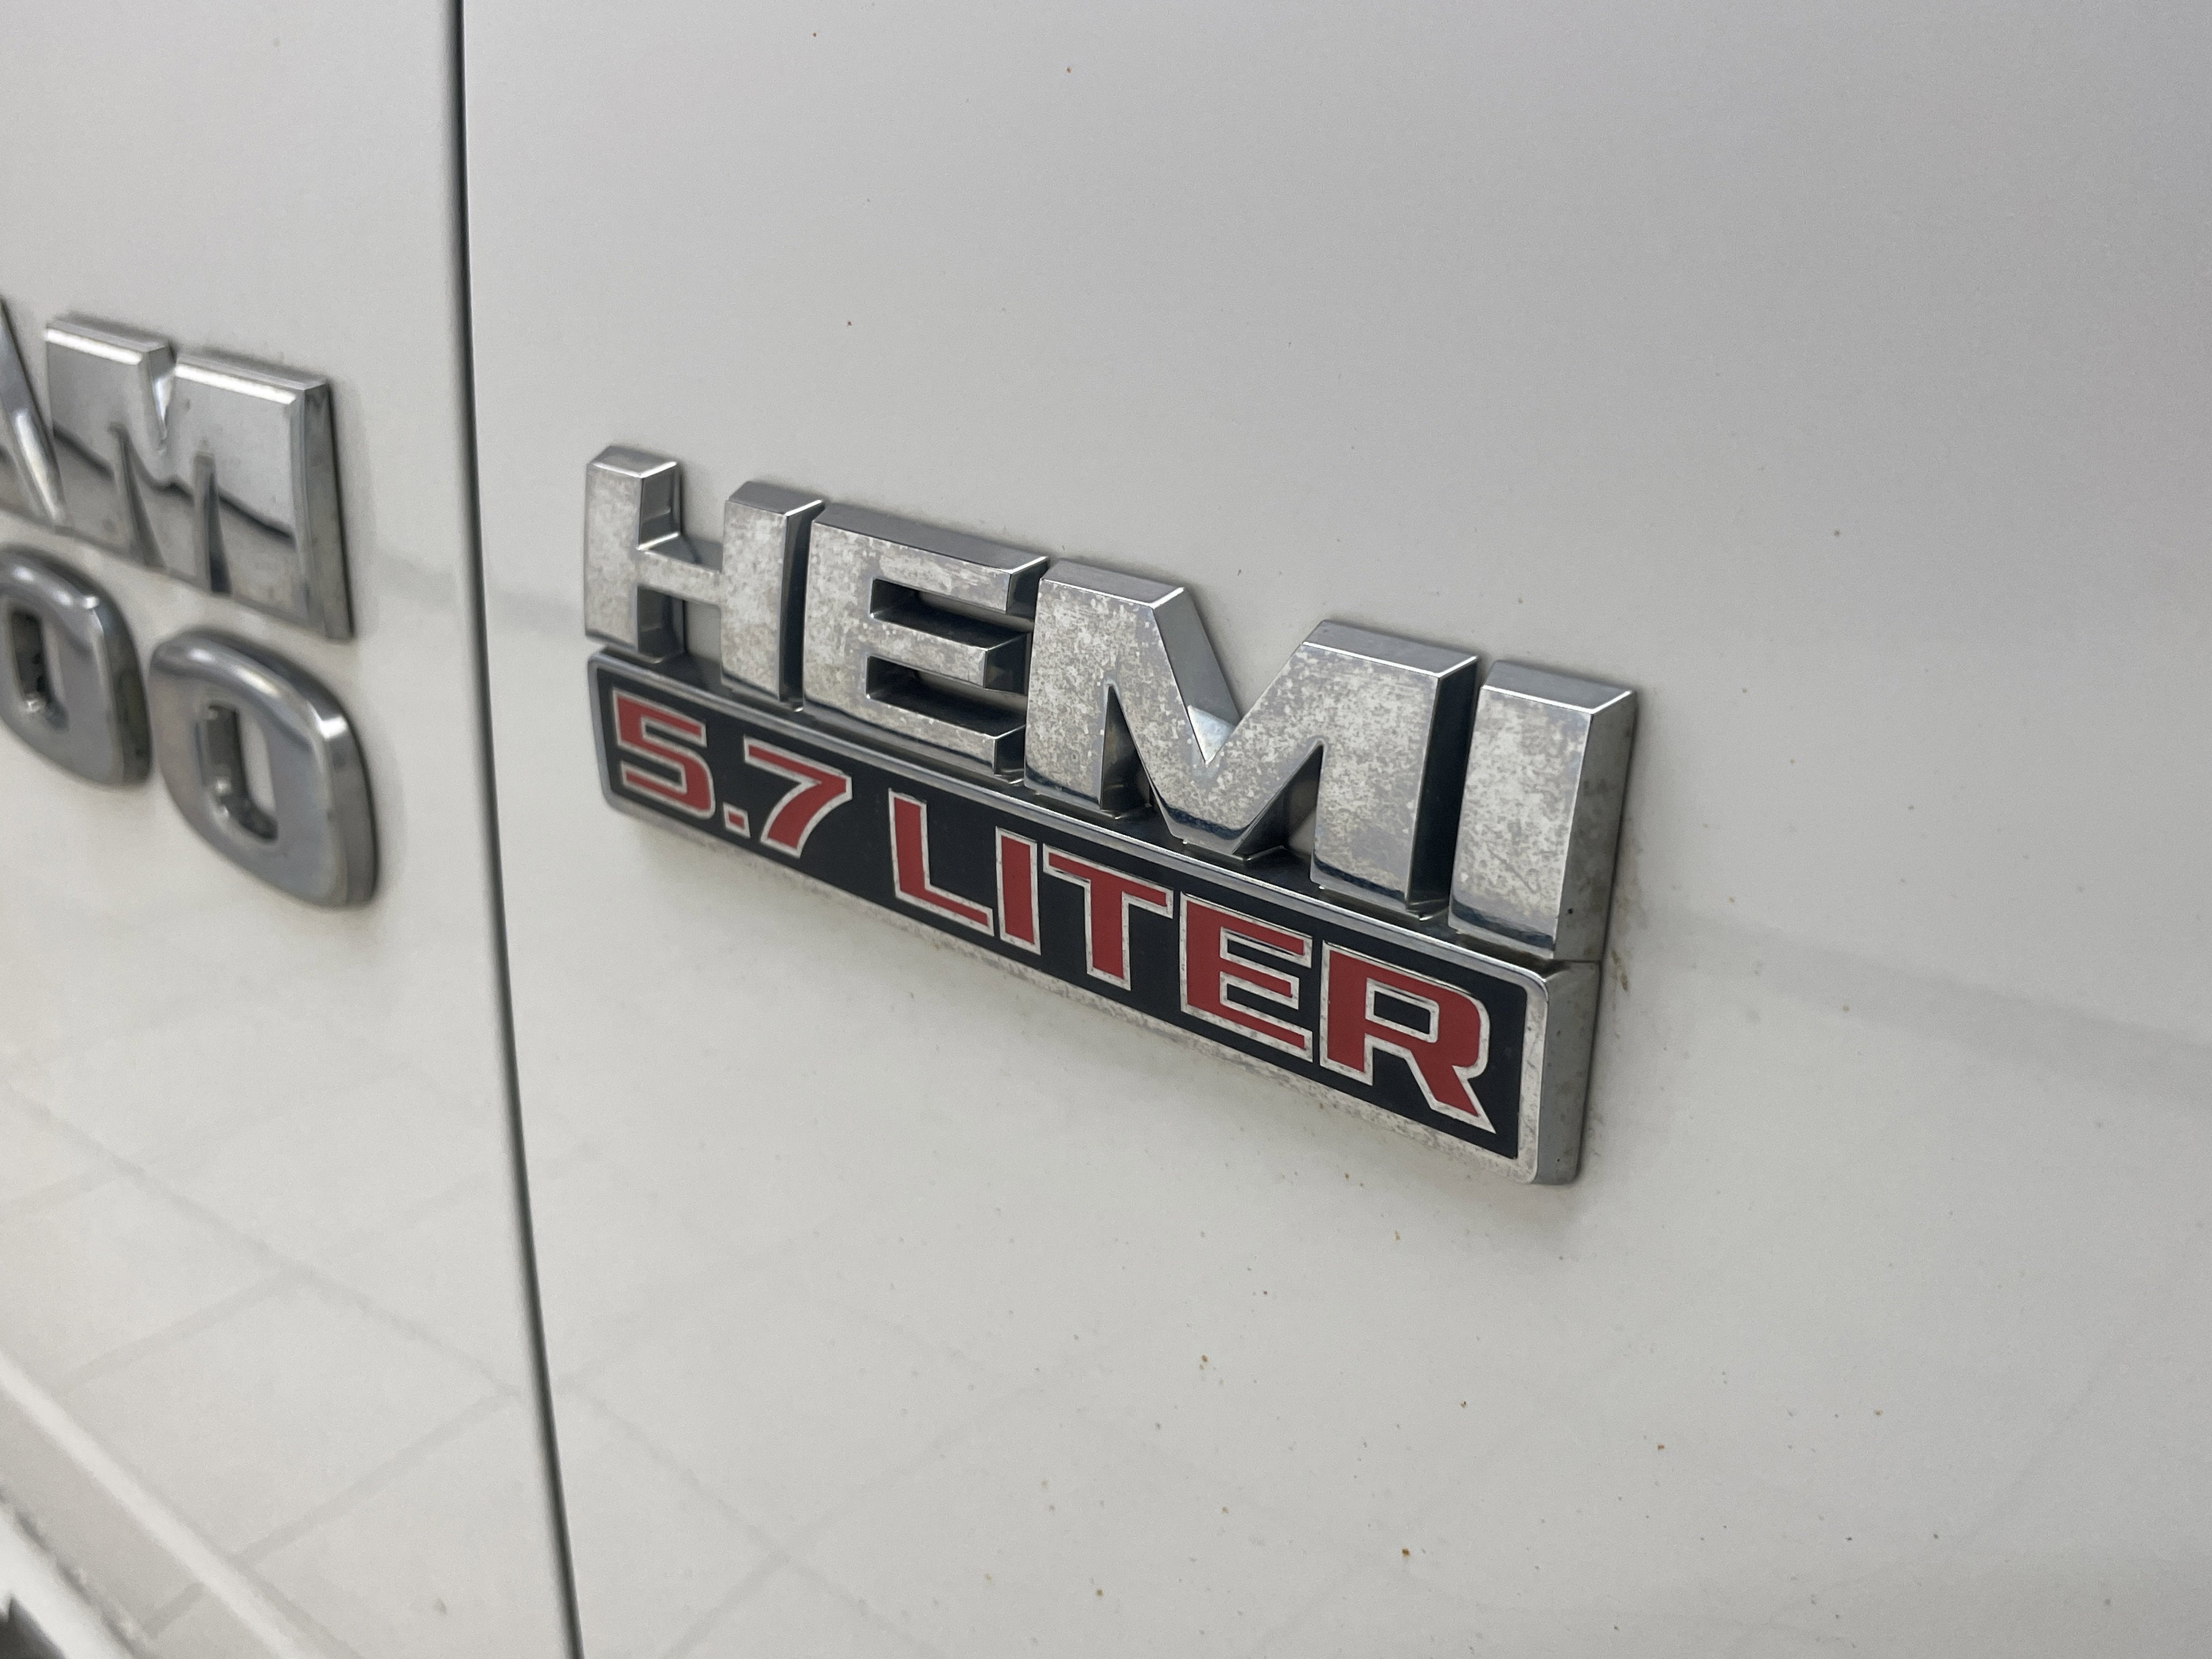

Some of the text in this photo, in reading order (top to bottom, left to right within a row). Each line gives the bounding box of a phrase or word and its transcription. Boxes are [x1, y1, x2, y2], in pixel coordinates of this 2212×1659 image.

[585, 445, 1638, 961] HEMI
[610, 689, 1495, 1134] 5.7 LITER
